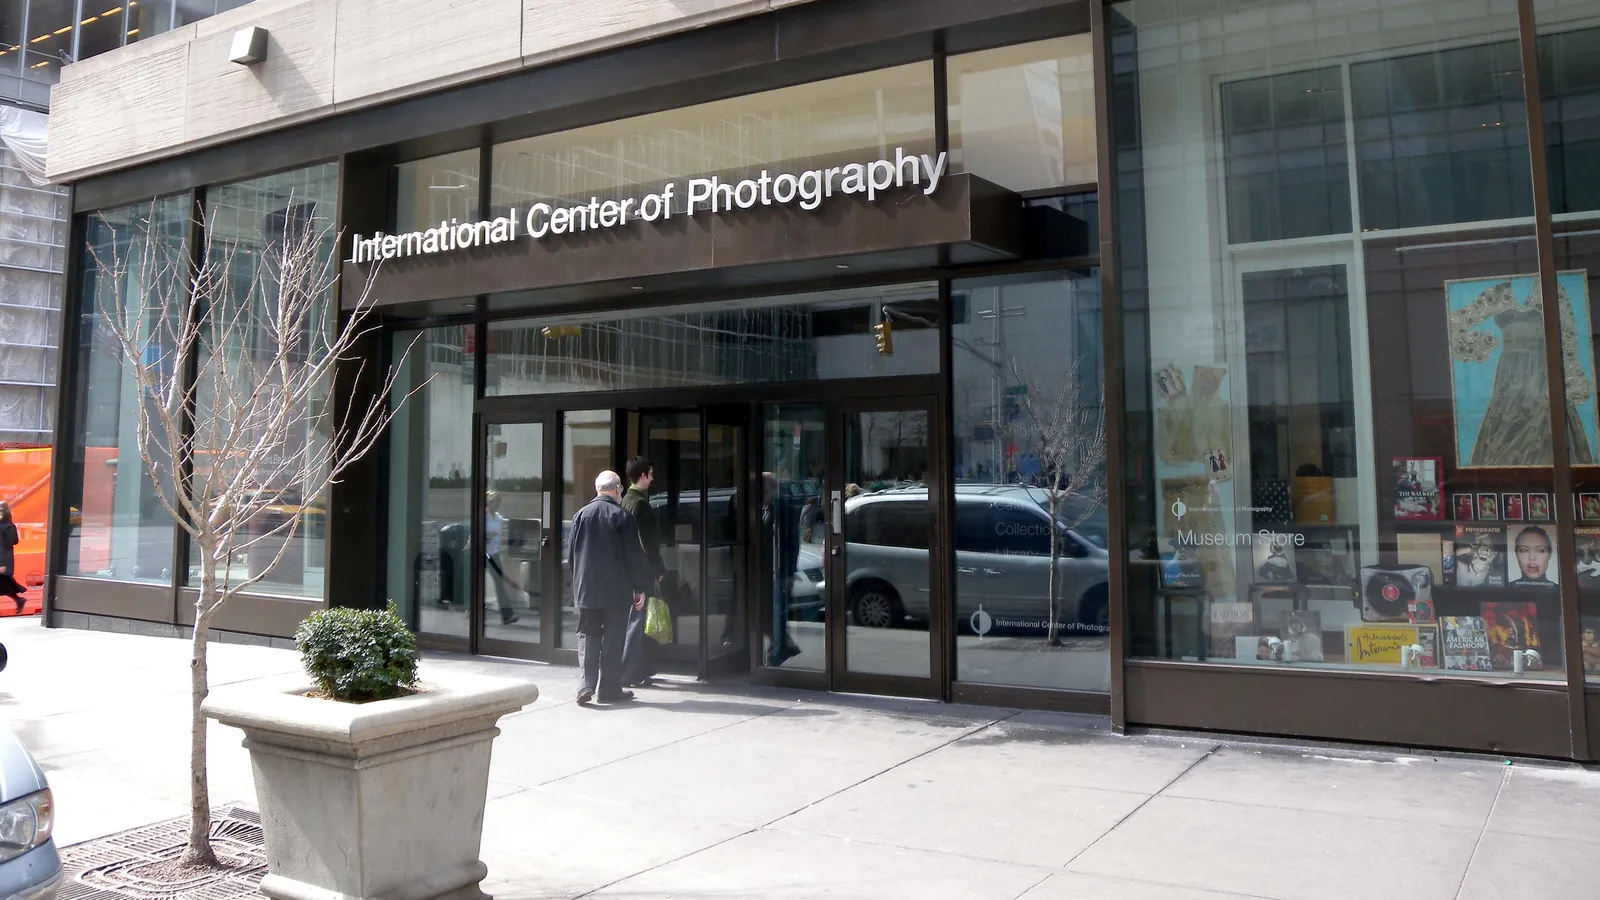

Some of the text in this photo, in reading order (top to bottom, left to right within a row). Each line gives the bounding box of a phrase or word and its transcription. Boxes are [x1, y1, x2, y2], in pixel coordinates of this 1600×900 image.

[352, 146, 946, 264] International Center of Photography
[1241, 505, 1273, 513] Photography
[1177, 528, 1305, 547] Museum Store
[1214, 610, 1249, 618] FASHION
[995, 619, 1040, 628] International
[1067, 622, 1075, 630] of
[1077, 622, 1110, 633] Photogra
[1356, 636, 1401, 659] Intervie
